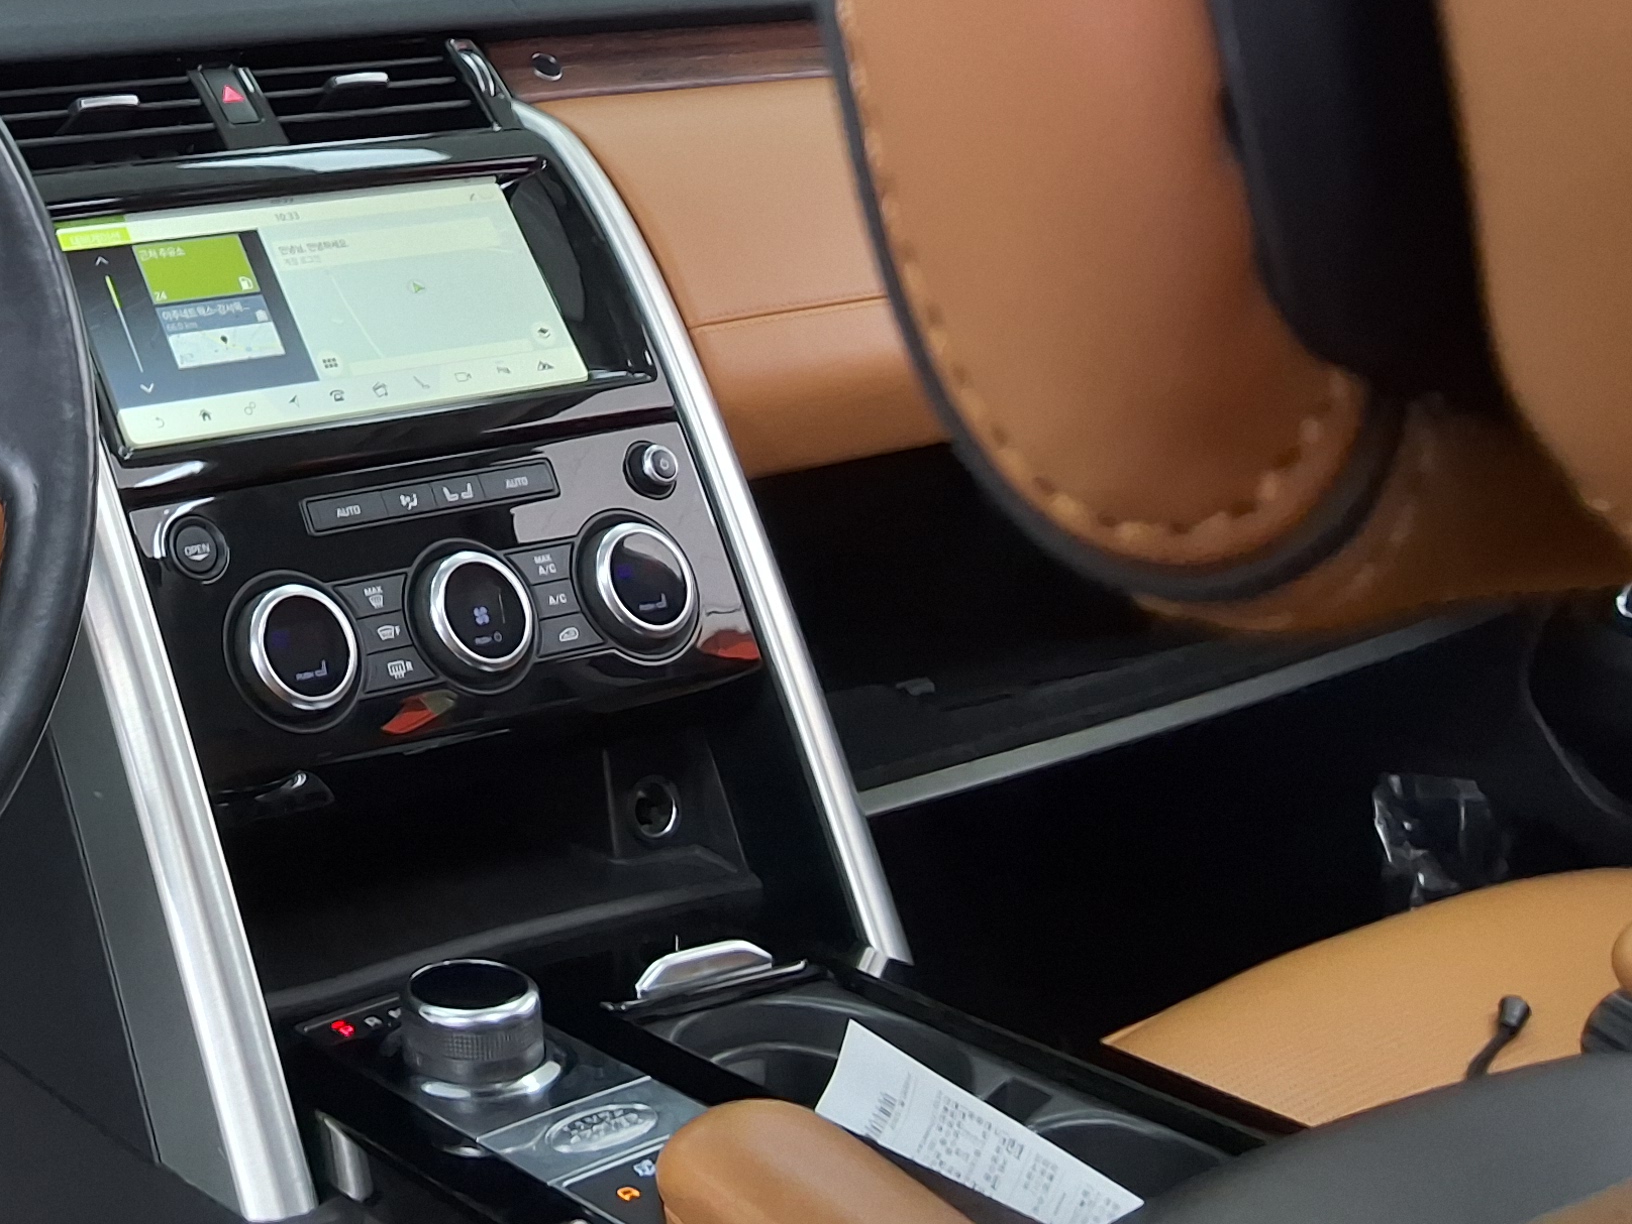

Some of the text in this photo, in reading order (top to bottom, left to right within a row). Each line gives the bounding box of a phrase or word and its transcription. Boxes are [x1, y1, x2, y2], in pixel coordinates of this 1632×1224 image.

[154, 291, 167, 301] 24
[505, 477, 528, 489] AUTO
[336, 504, 361, 518] AUTO
[184, 542, 210, 557] OPEN
[538, 562, 557, 575] A/C
[548, 593, 567, 606] A/C
